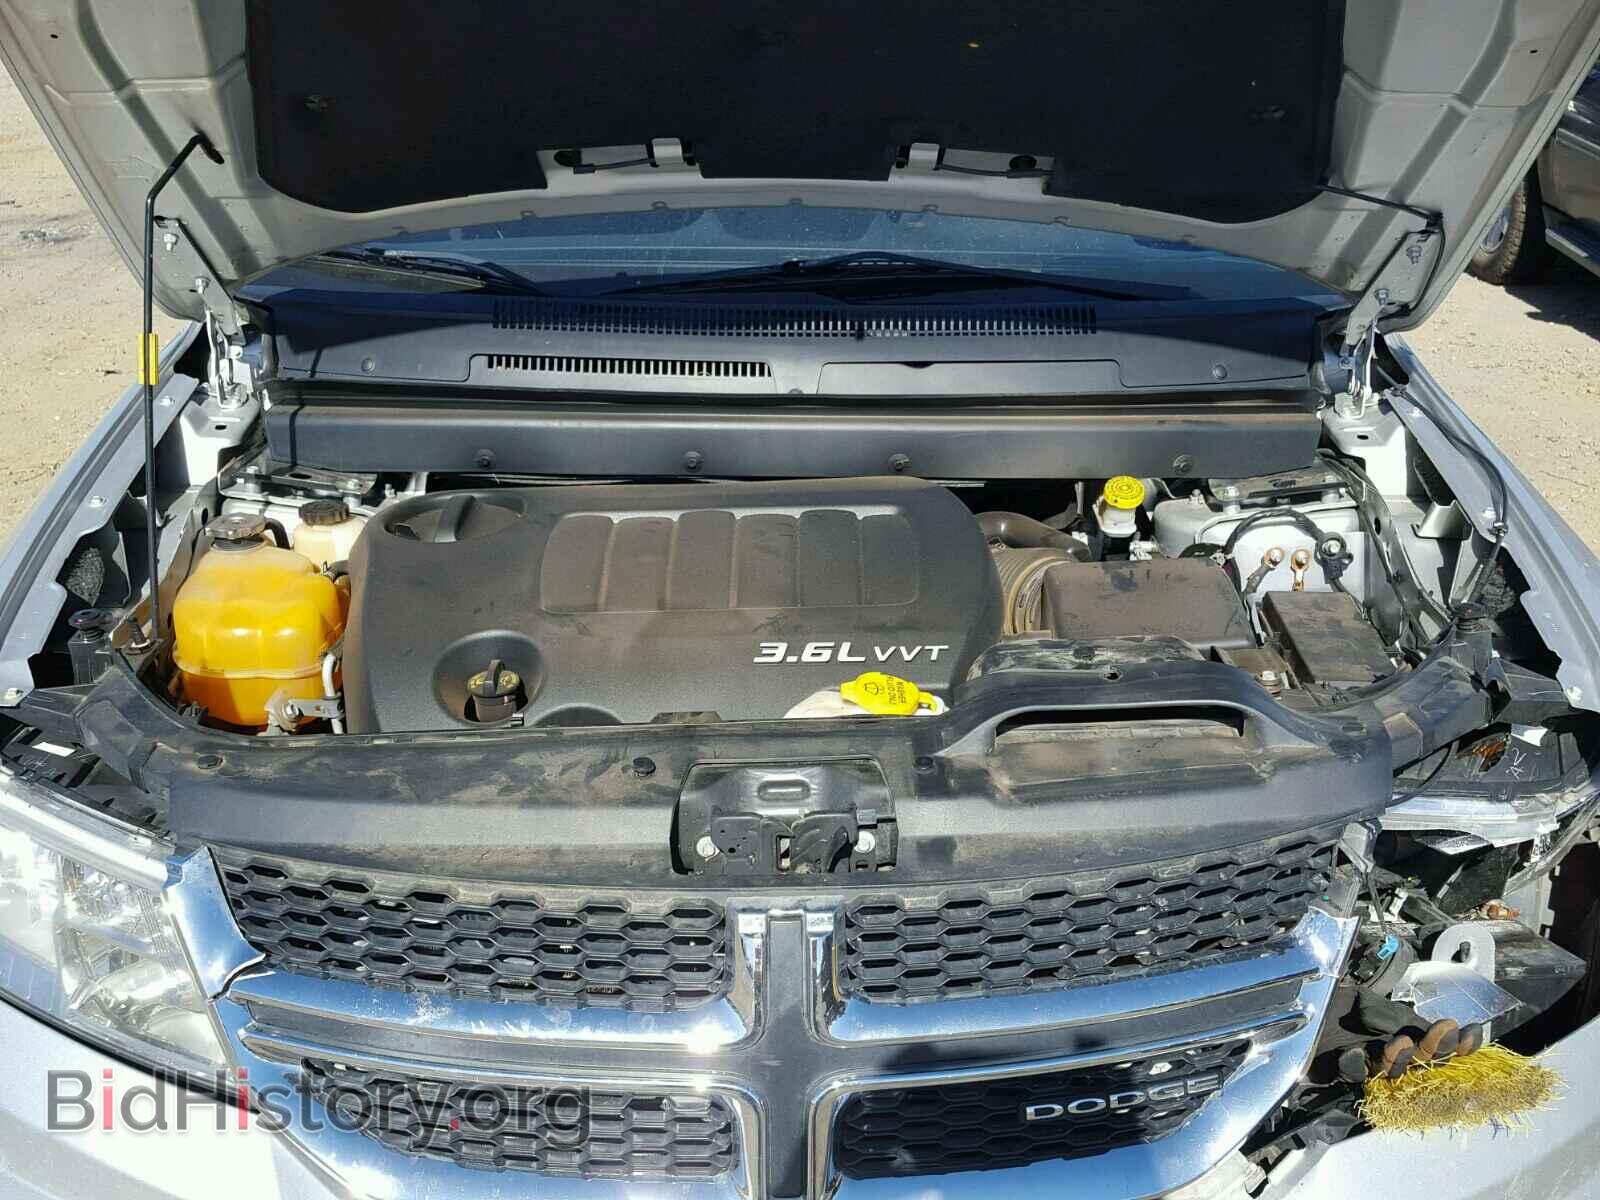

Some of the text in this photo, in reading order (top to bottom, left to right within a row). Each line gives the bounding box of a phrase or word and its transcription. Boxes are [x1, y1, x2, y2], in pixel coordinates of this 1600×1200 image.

[753, 641, 949, 663] 3.6L VVT
[1026, 1074, 1221, 1121] DODGE
